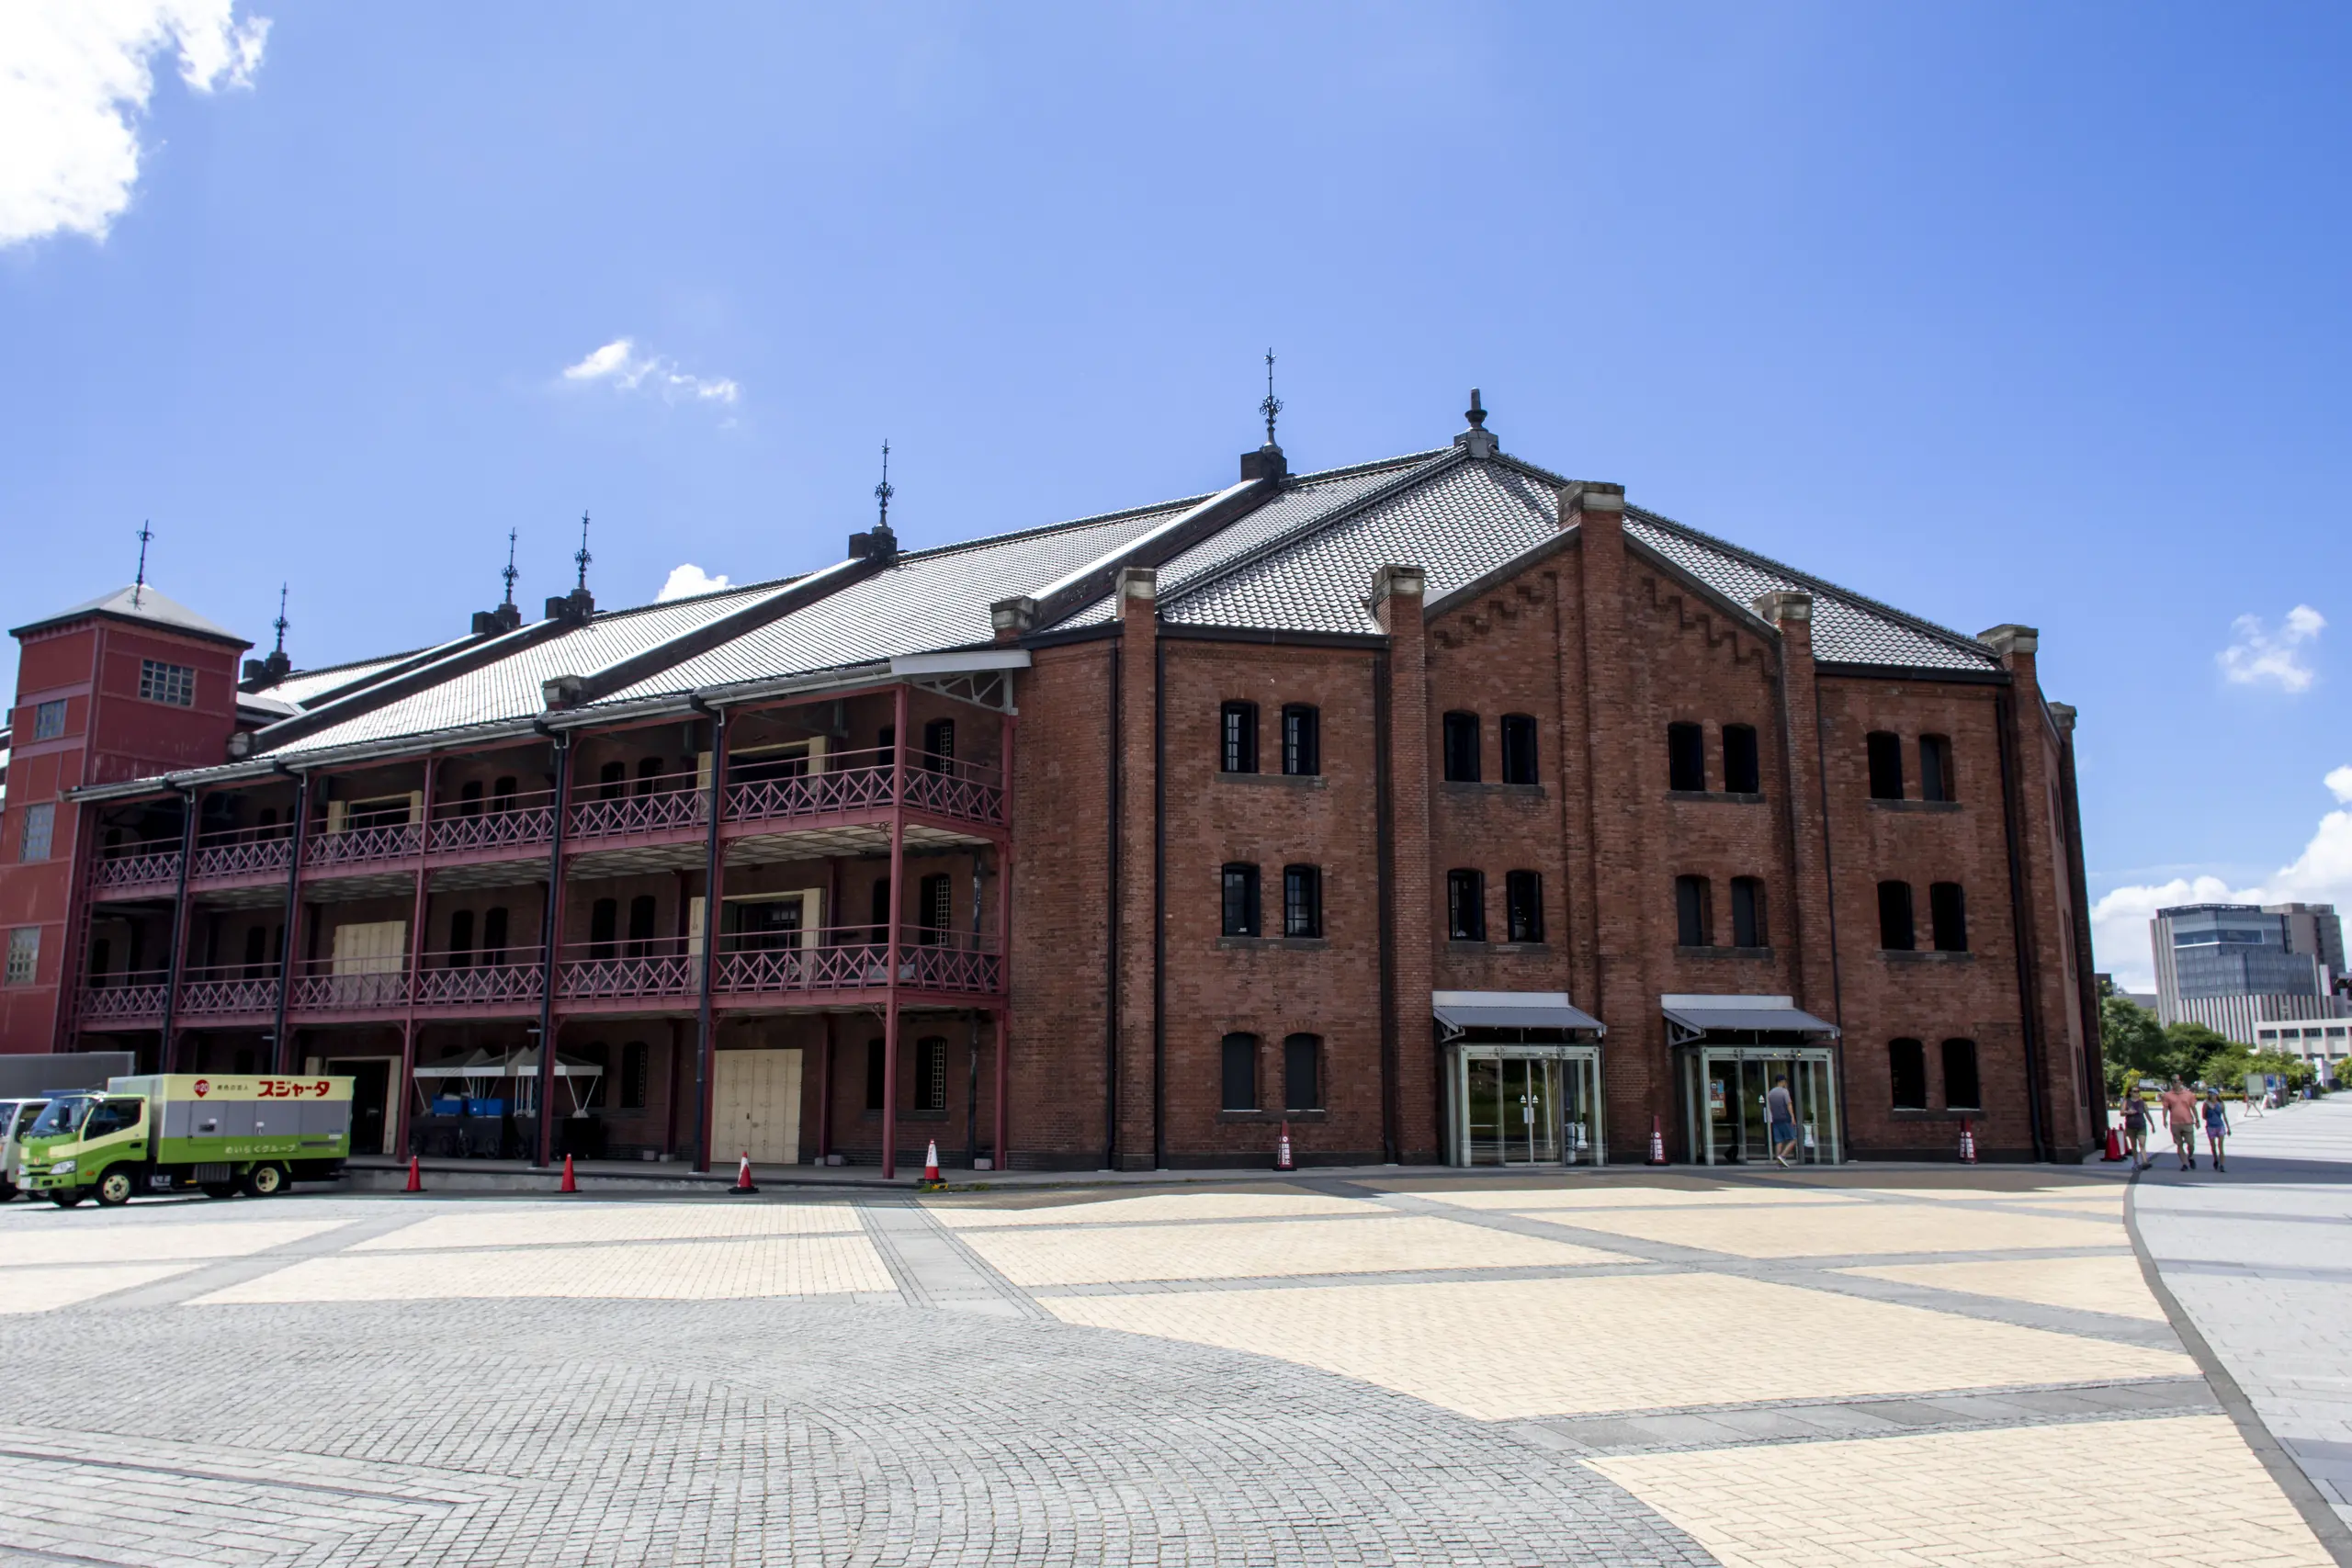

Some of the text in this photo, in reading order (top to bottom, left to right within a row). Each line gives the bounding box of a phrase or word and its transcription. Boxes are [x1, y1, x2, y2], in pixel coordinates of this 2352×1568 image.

[257, 1081, 331, 1097] スジャータ
